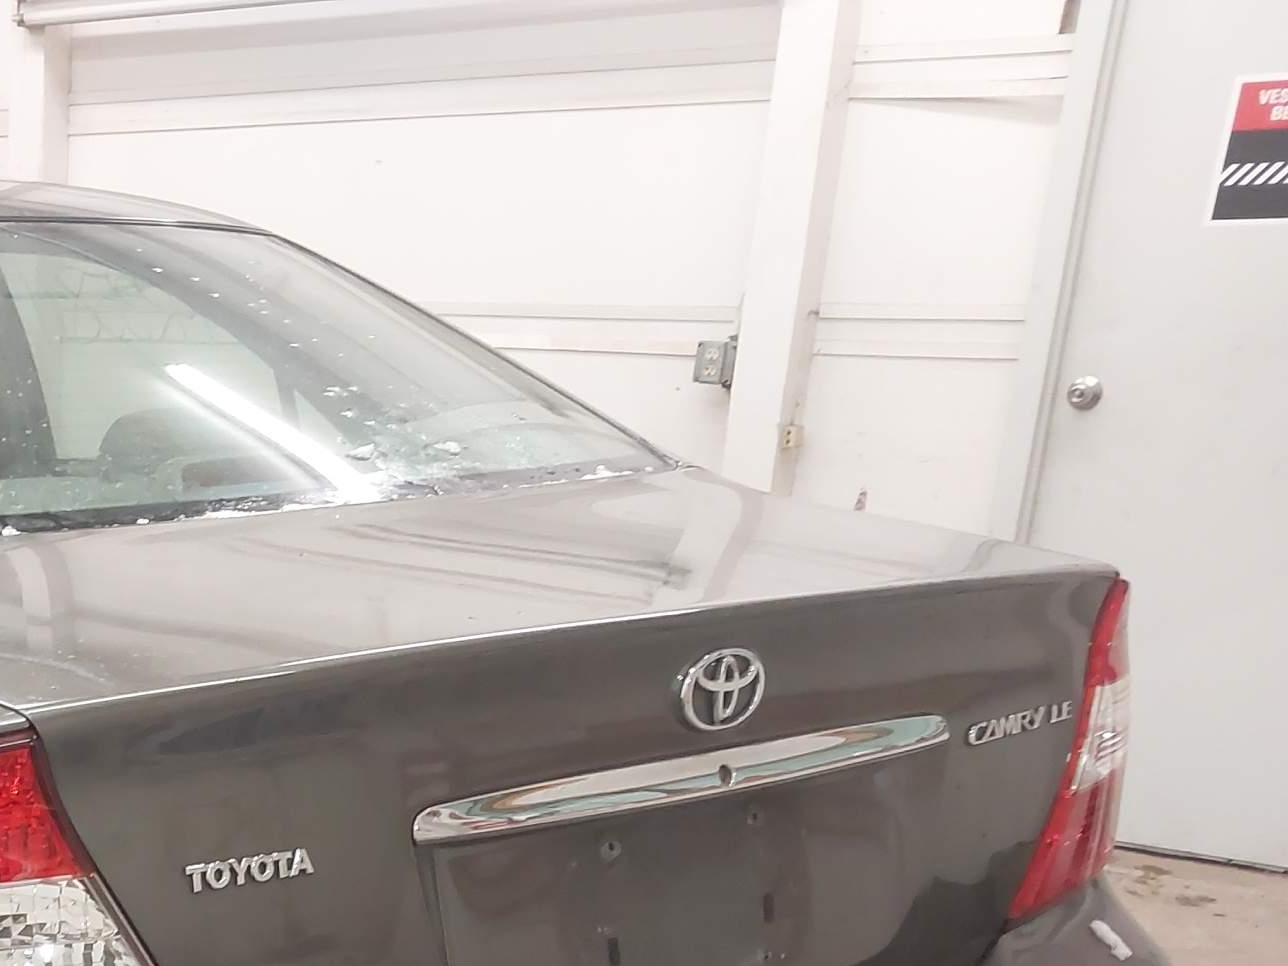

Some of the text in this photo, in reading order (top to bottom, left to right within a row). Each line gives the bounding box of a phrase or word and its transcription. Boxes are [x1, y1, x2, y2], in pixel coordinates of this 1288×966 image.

[968, 700, 1073, 745] CAMRY LE
[185, 848, 314, 893] TOYOTA
